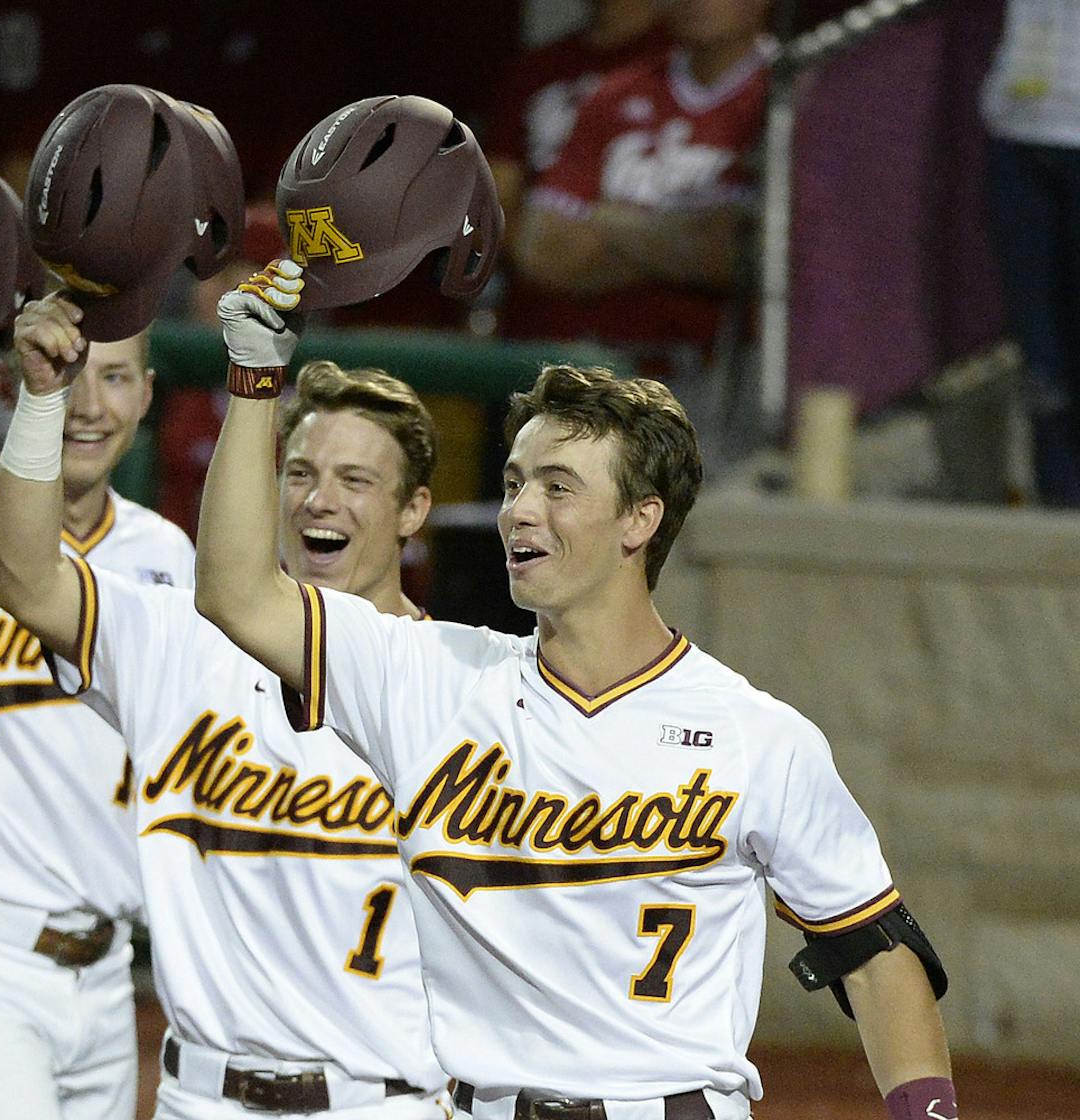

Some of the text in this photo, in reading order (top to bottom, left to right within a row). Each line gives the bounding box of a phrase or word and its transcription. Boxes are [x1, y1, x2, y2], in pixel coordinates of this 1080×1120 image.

[41, 144, 63, 210] EASTON
[319, 108, 356, 151] EASTON
[286, 206, 364, 267] M
[143, 709, 396, 836] Minneso
[397, 739, 740, 853] Minnesota
[344, 882, 399, 979] 1
[628, 903, 696, 1003] 7
